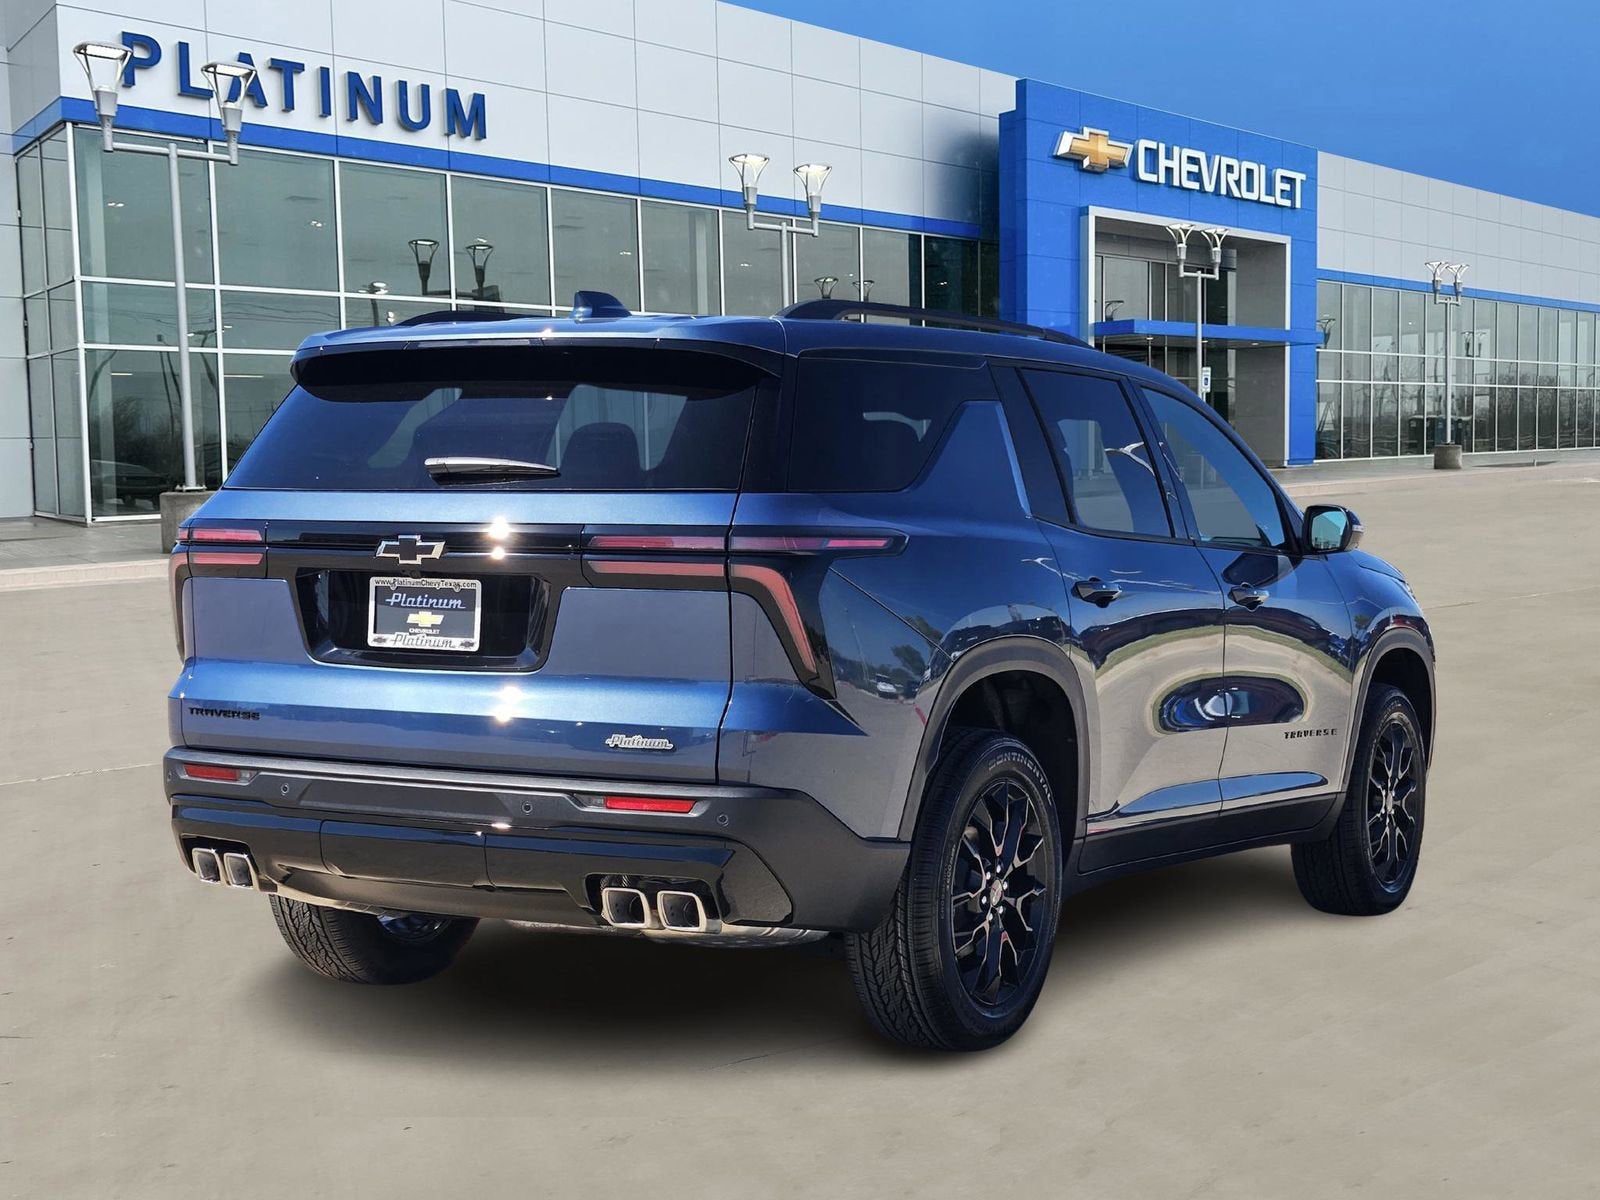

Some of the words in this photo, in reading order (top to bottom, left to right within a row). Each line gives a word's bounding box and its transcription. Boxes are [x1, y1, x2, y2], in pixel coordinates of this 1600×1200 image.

[121, 31, 487, 140] PLATINUM
[1135, 139, 1306, 209] CHEVROLET
[385, 592, 466, 609] Platinum
[390, 633, 456, 649] Platinum
[188, 706, 260, 721] TRAVERSE
[605, 733, 674, 750] Platinum
[1284, 728, 1338, 739] TRAVERSE
